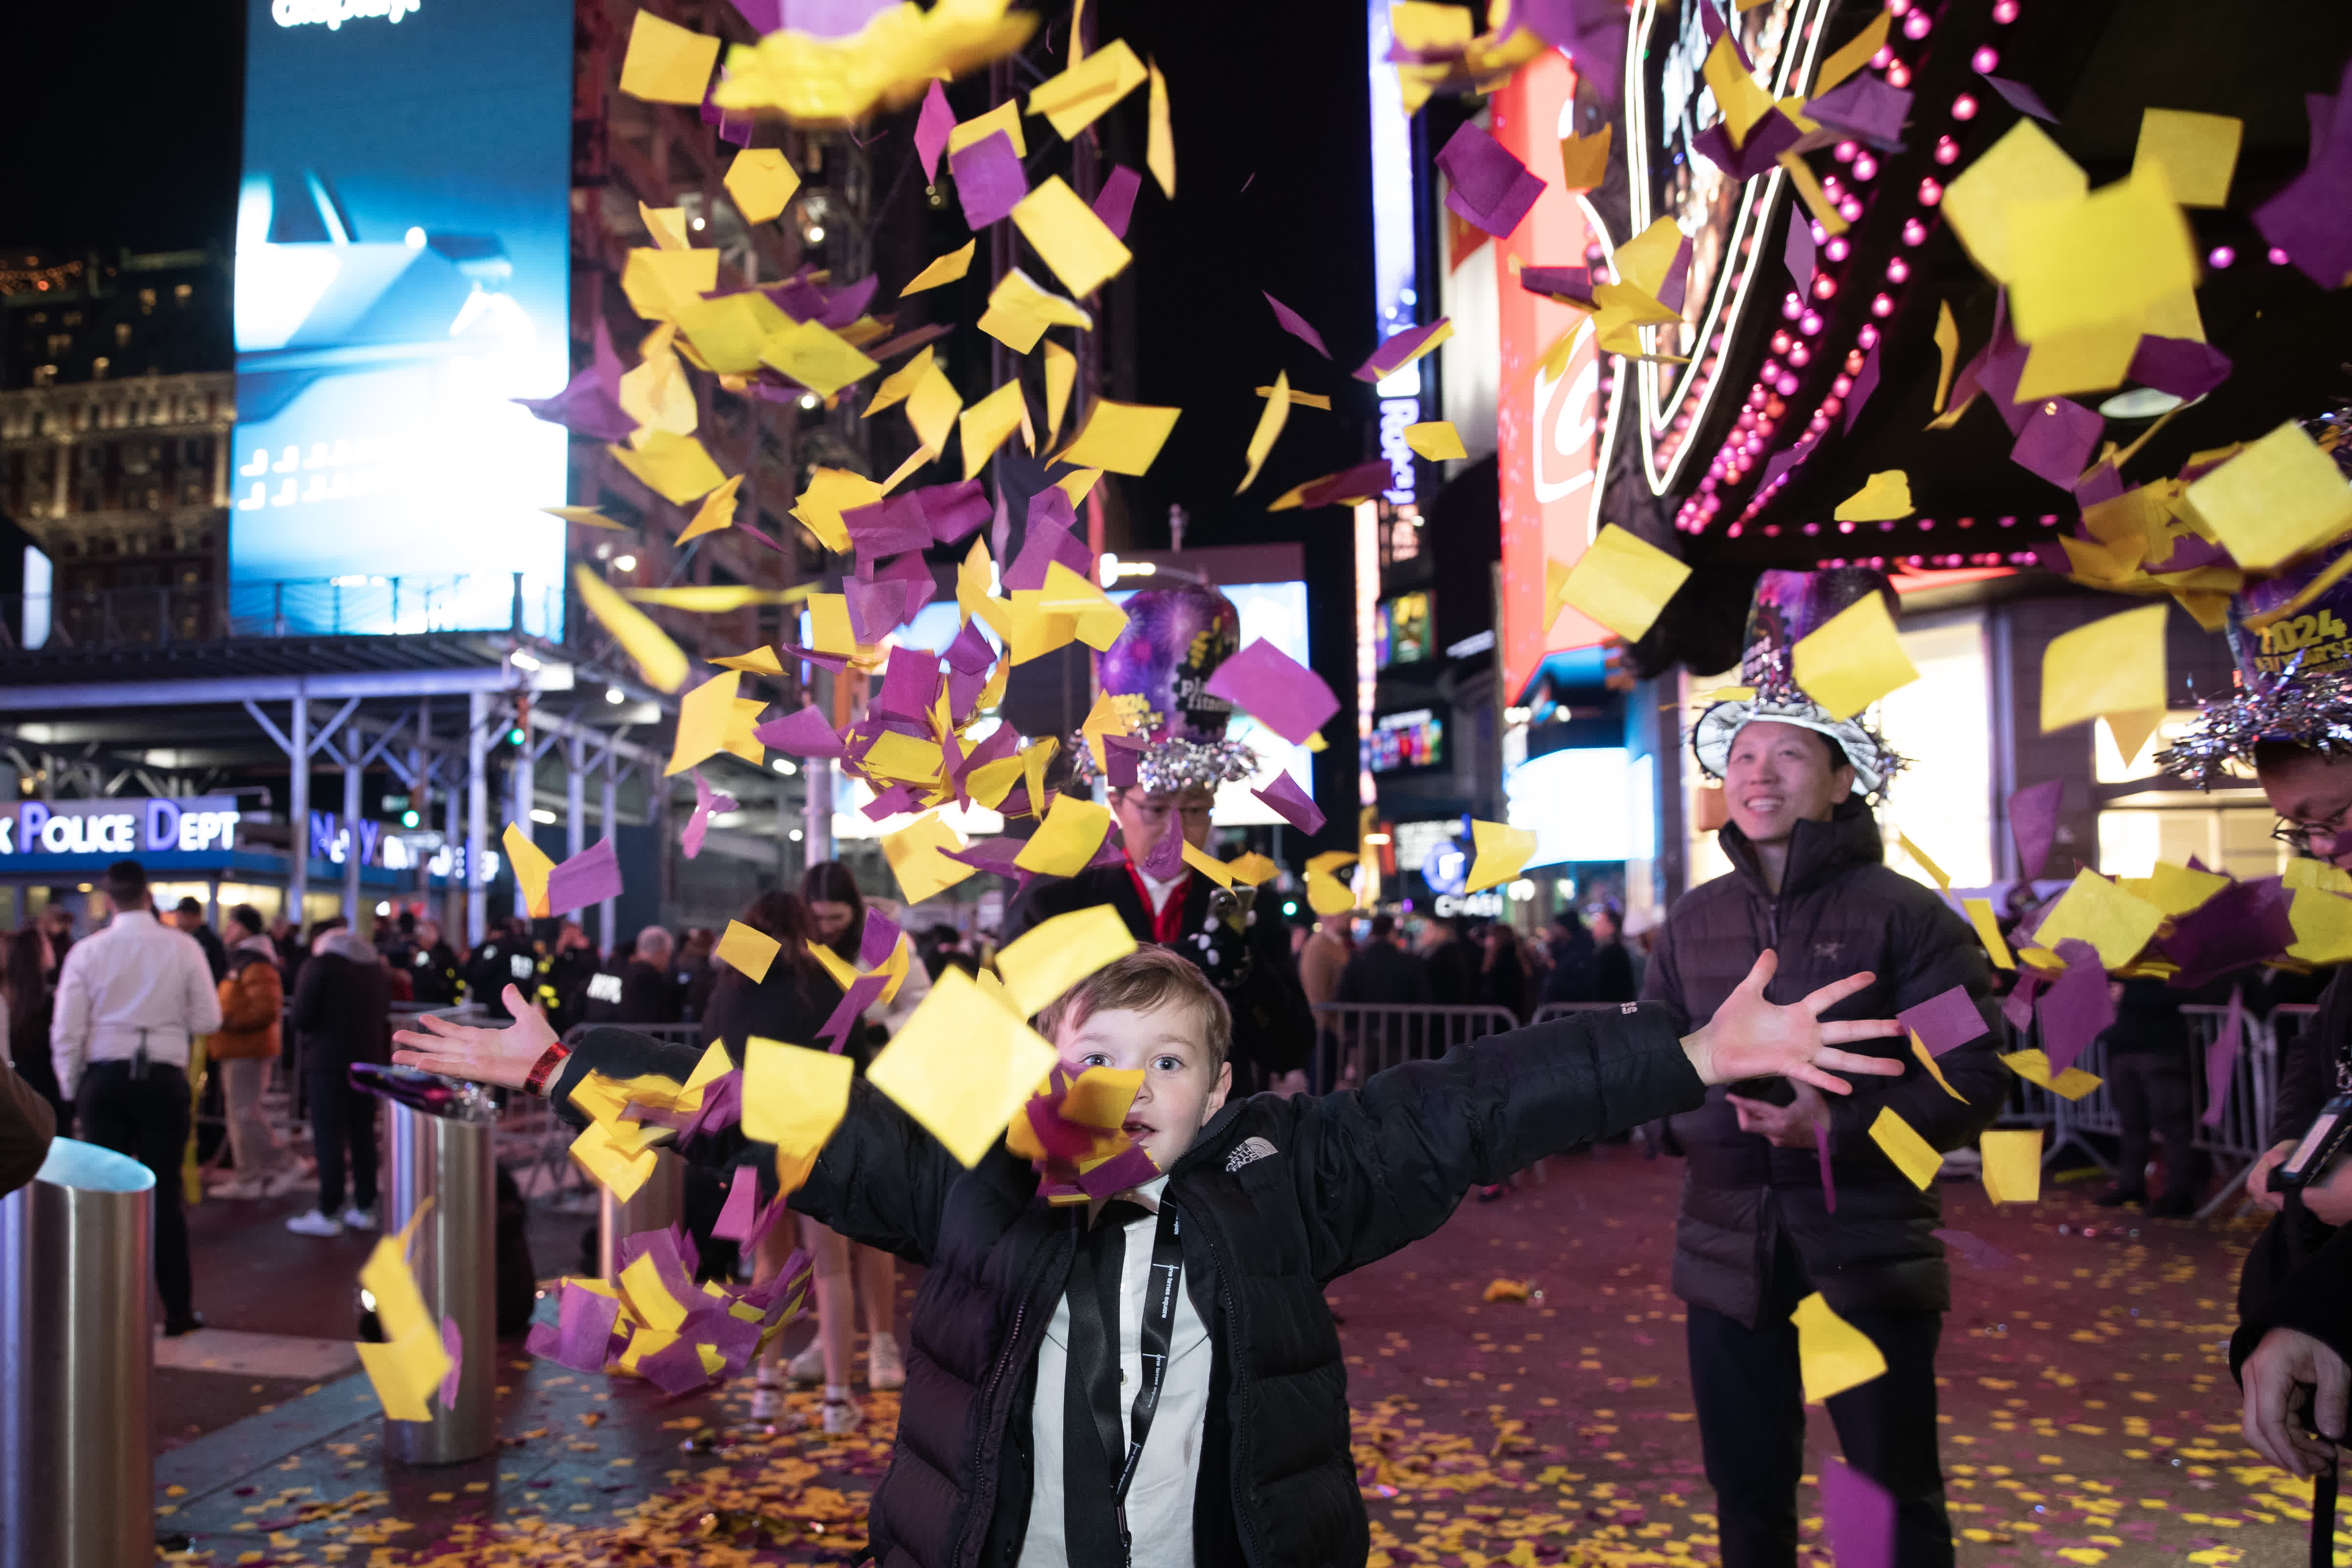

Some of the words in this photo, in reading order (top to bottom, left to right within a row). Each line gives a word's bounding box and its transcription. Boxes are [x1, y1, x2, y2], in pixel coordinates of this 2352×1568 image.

[19, 801, 135, 854] POLICE
[146, 798, 240, 851] DEPT
[1226, 1143, 1248, 1159] THE
[1226, 1147, 1253, 1172] ORTH
[1232, 1153, 1261, 1172] FACE
[1148, 1387, 1157, 1408] square
